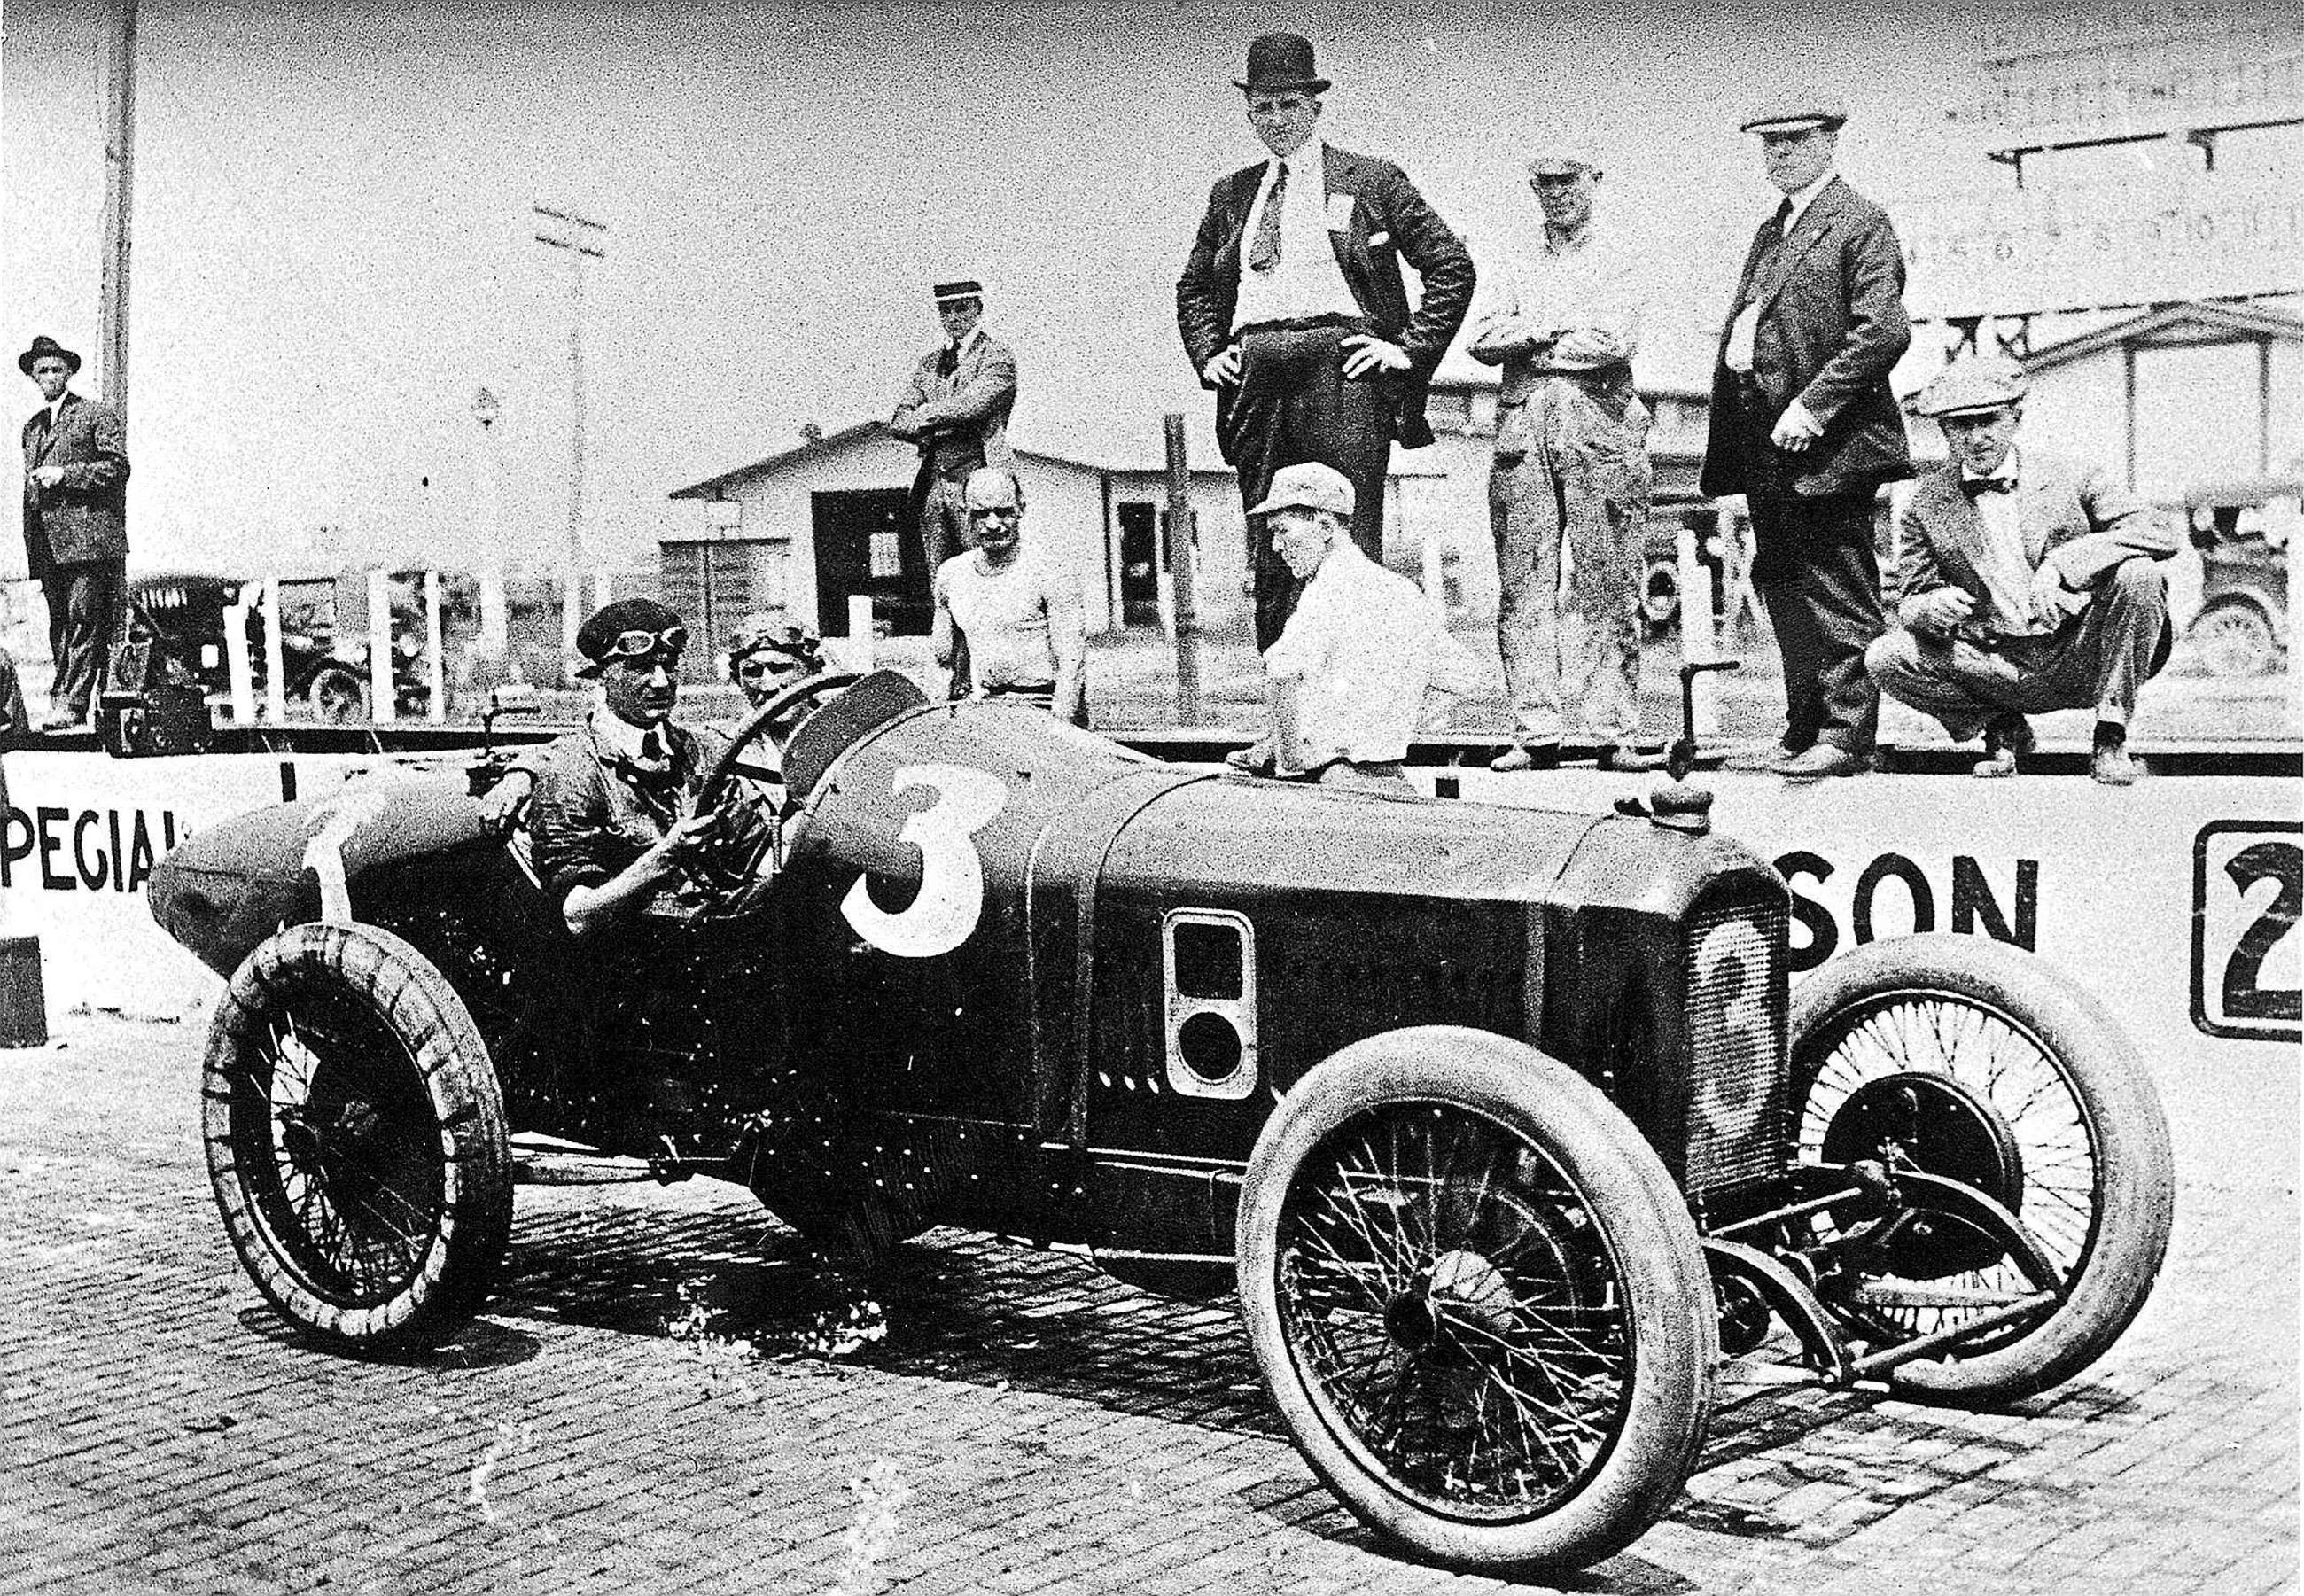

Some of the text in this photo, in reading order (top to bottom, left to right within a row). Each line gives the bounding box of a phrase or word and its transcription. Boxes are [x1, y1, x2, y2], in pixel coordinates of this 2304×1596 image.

[839, 762, 1008, 958] 3
[1772, 850, 2039, 973] SON
[1695, 918, 1776, 1140] 3
